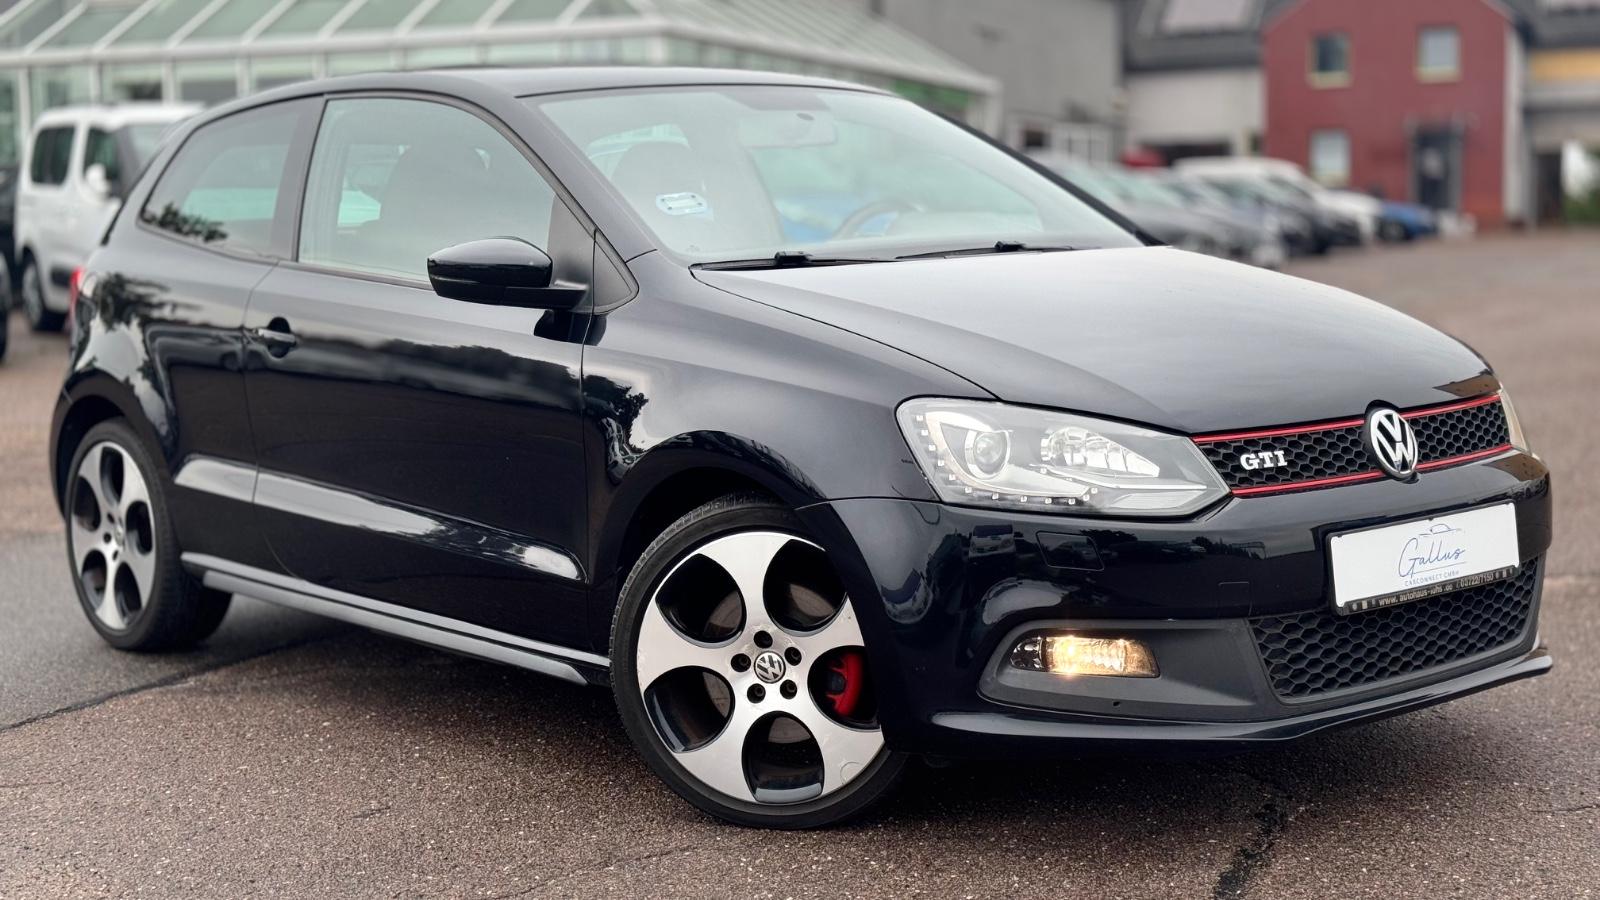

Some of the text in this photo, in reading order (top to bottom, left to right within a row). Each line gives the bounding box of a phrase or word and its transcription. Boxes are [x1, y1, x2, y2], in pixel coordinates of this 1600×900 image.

[1239, 450, 1288, 471] GTI
[1370, 408, 1419, 474] VW
[1398, 537, 1466, 579] Gallus
